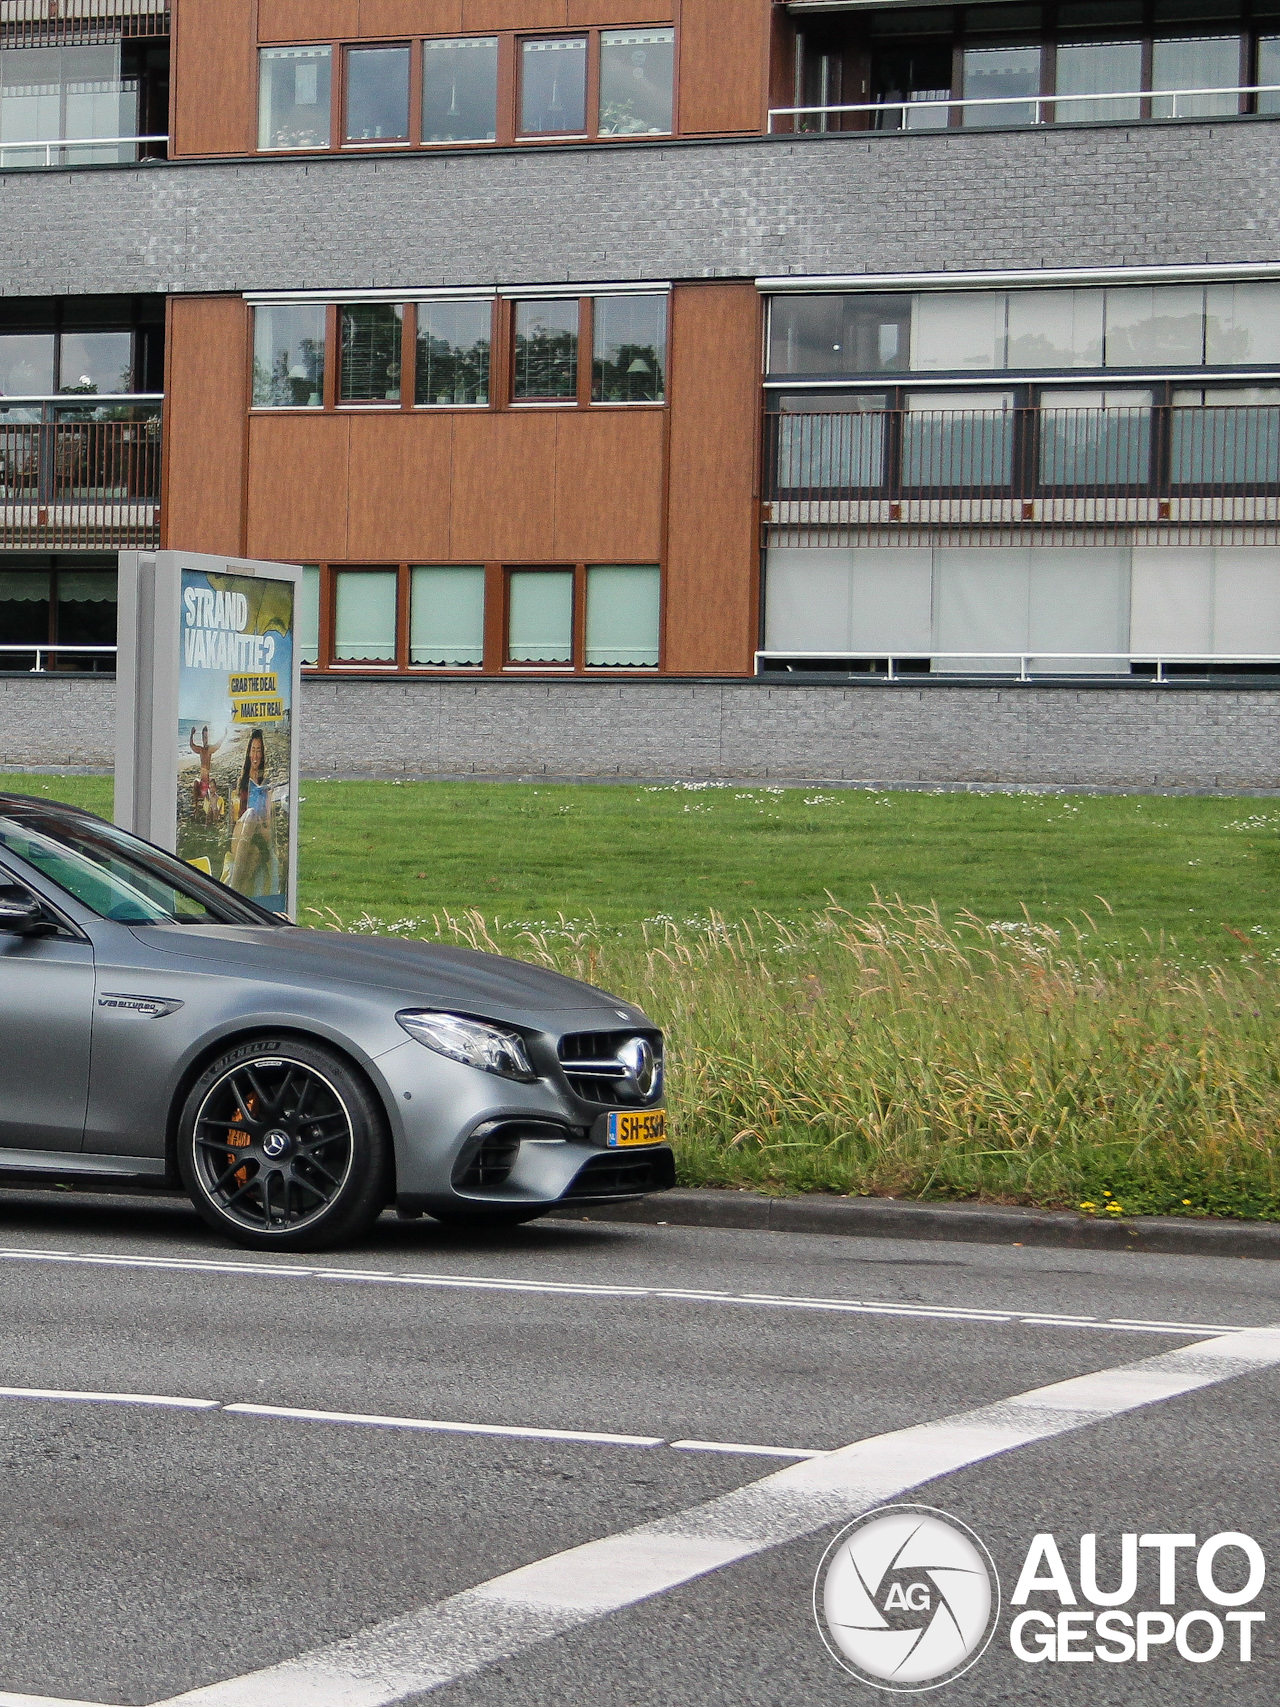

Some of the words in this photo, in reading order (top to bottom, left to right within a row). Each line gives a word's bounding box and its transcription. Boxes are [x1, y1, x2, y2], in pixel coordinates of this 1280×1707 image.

[184, 587, 247, 631] STRAND
[185, 628, 275, 673] VAKANTIE?
[231, 677, 248, 692] GRAB
[248, 677, 259, 691] THE
[260, 676, 276, 691] DEAL
[241, 704, 258, 717] MAKE
[259, 703, 266, 716] IT
[267, 702, 281, 716] REAL
[98, 999, 118, 1007] V8
[118, 1001, 156, 1009] BITURBO
[213, 1042, 277, 1072] MICHELIN
